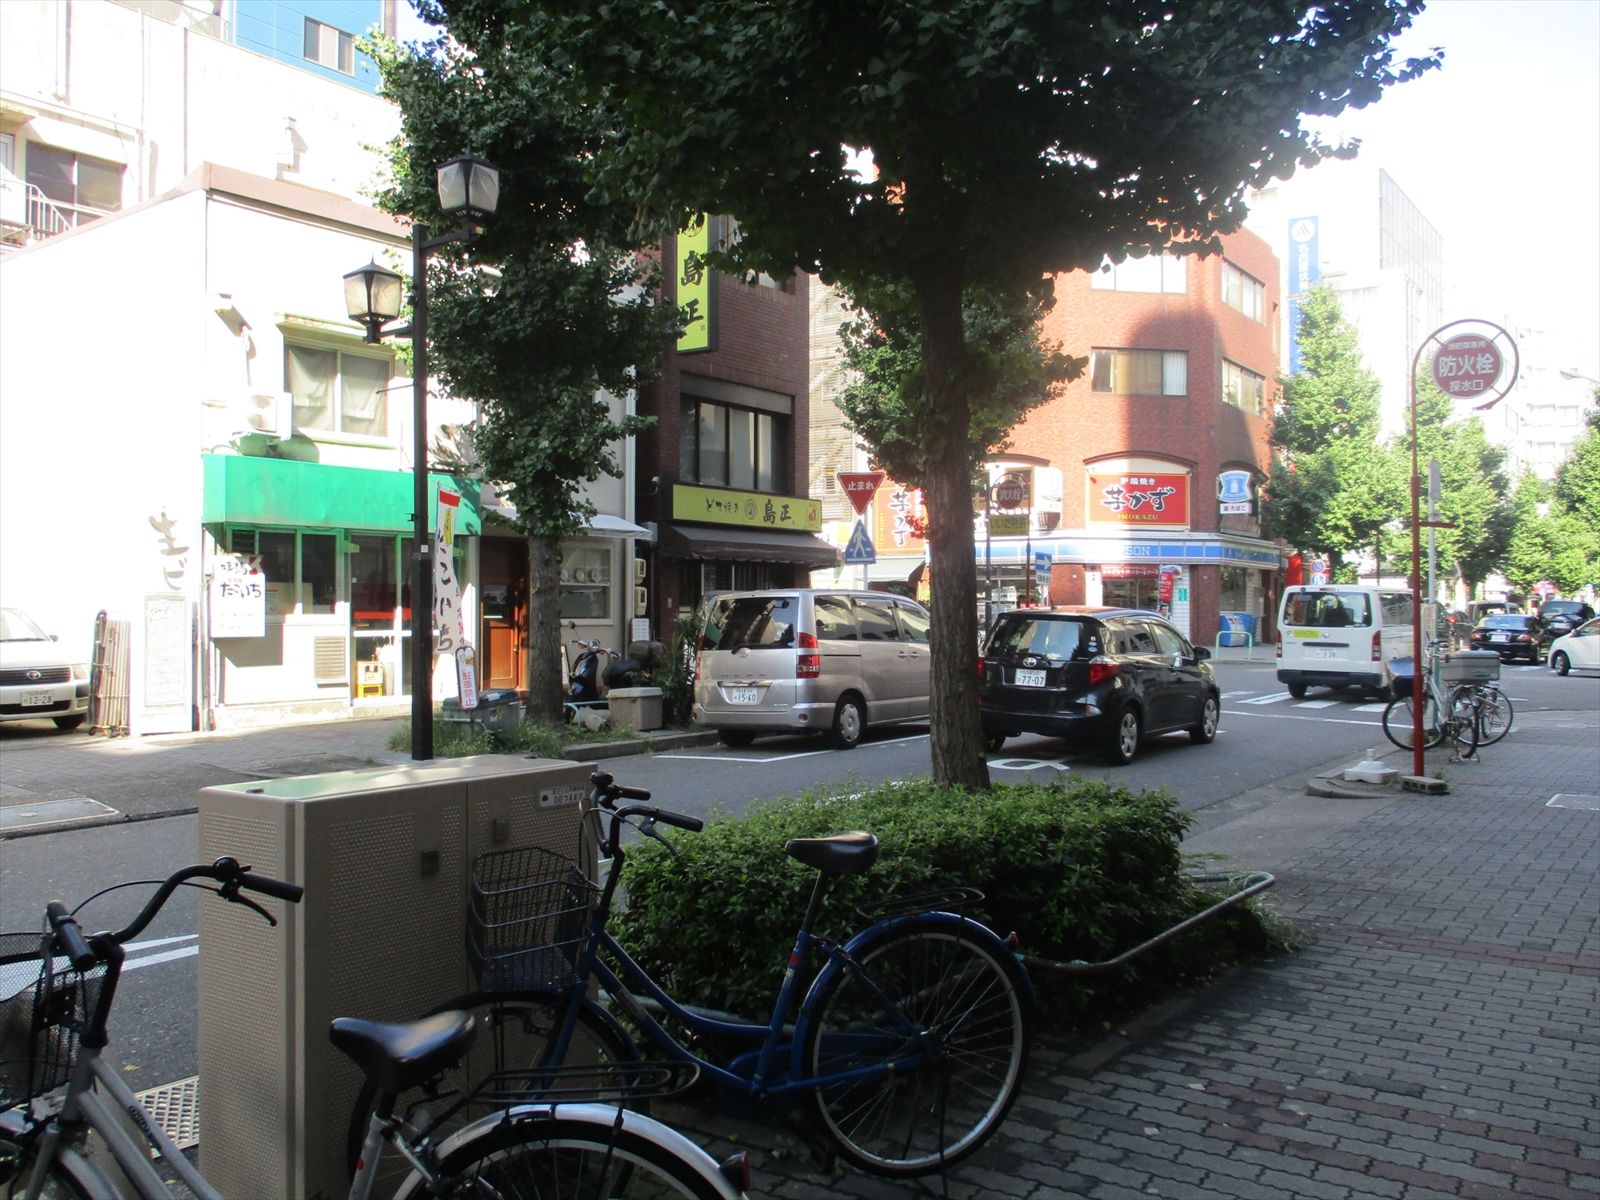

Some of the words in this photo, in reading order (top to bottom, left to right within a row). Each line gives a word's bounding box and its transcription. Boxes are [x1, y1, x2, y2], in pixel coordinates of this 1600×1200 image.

[1439, 353, 1494, 377] 防火栓
[847, 481, 874, 490] 止まれ
[1101, 485, 1176, 511] 芋かず
[763, 499, 791, 524] 島正
[220, 582, 262, 598] たこいち
[1022, 676, 1045, 685] 77-07
